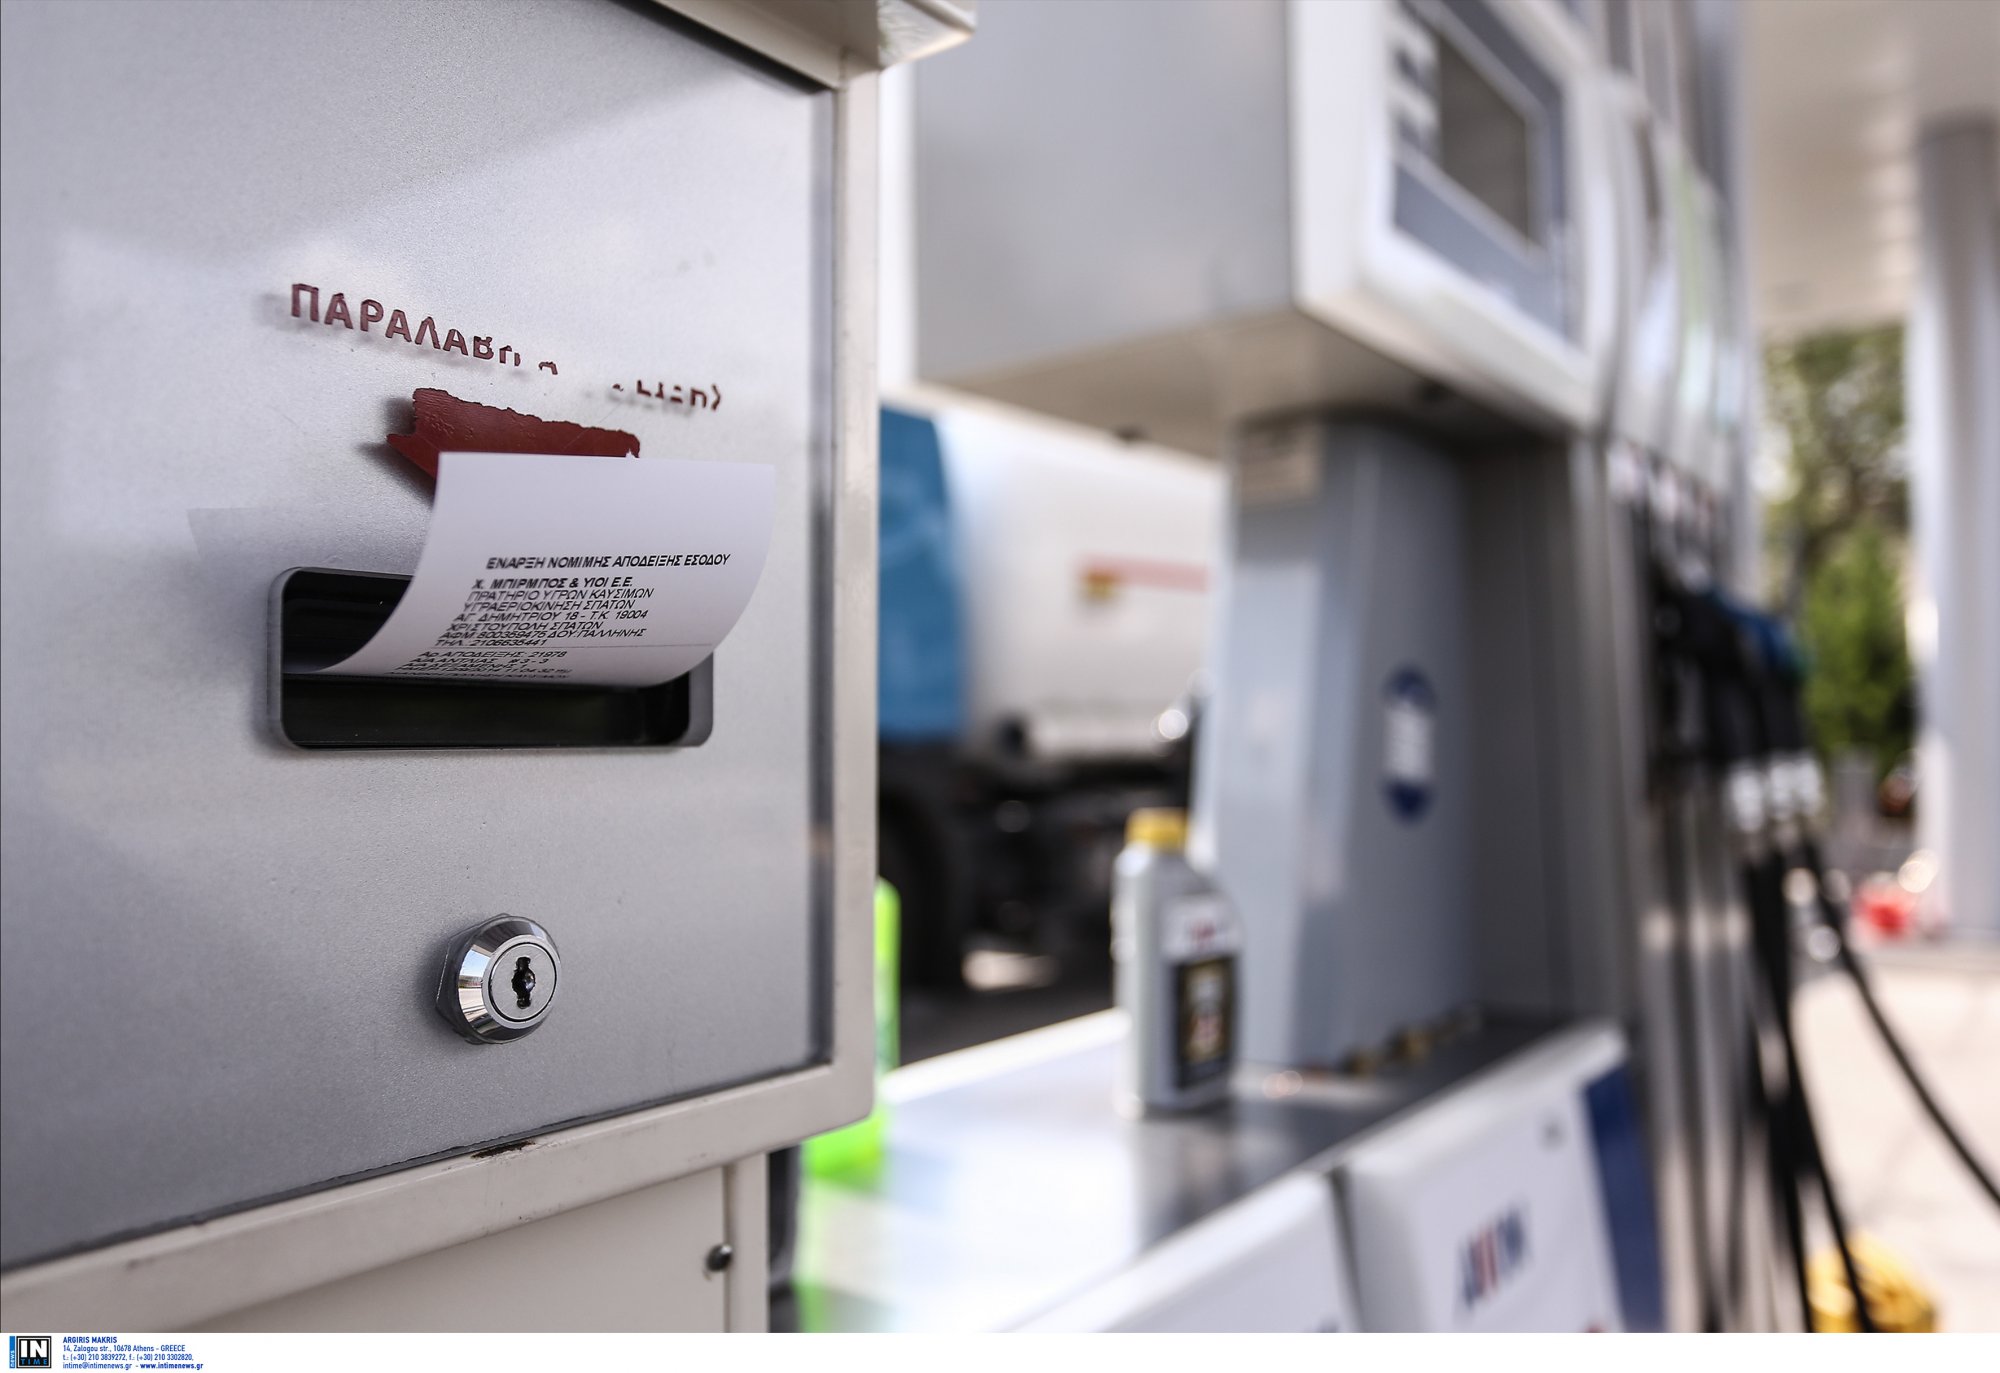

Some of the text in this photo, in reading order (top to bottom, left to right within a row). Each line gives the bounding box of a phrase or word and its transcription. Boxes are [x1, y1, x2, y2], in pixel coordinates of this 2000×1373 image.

[486, 554, 731, 570] ΕΝΑΡΞΗ ΝΟΜΙΜΗΣ ΑΠΟΔΕΙΞΗΣ ΕΣΟΔΟΥ
[490, 578, 568, 589] ΜΠΙΡΜΠΟΣ
[569, 578, 579, 588] &
[583, 577, 609, 588] ΥΙΟΙ
[611, 576, 633, 588] Ε.Ε.
[466, 588, 654, 601] ΠΡΑΤΗΡΙΟ ΥΓΡΩΝ ΚΑΥΣΙΜΩΝ
[463, 599, 636, 612] ΥΓΡΑΕΡΙΟΚΙΝΗΣΗ ΣΠΑΤΩΝ
[478, 611, 561, 621] ΔΗΜΗΤΡΙΟΥ
[565, 611, 579, 620] 18
[615, 610, 649, 620] 19004
[446, 621, 604, 631] ΧΡΙΣΤΟΥΠΟΛΗ ΣΠΑΤΩΝ
